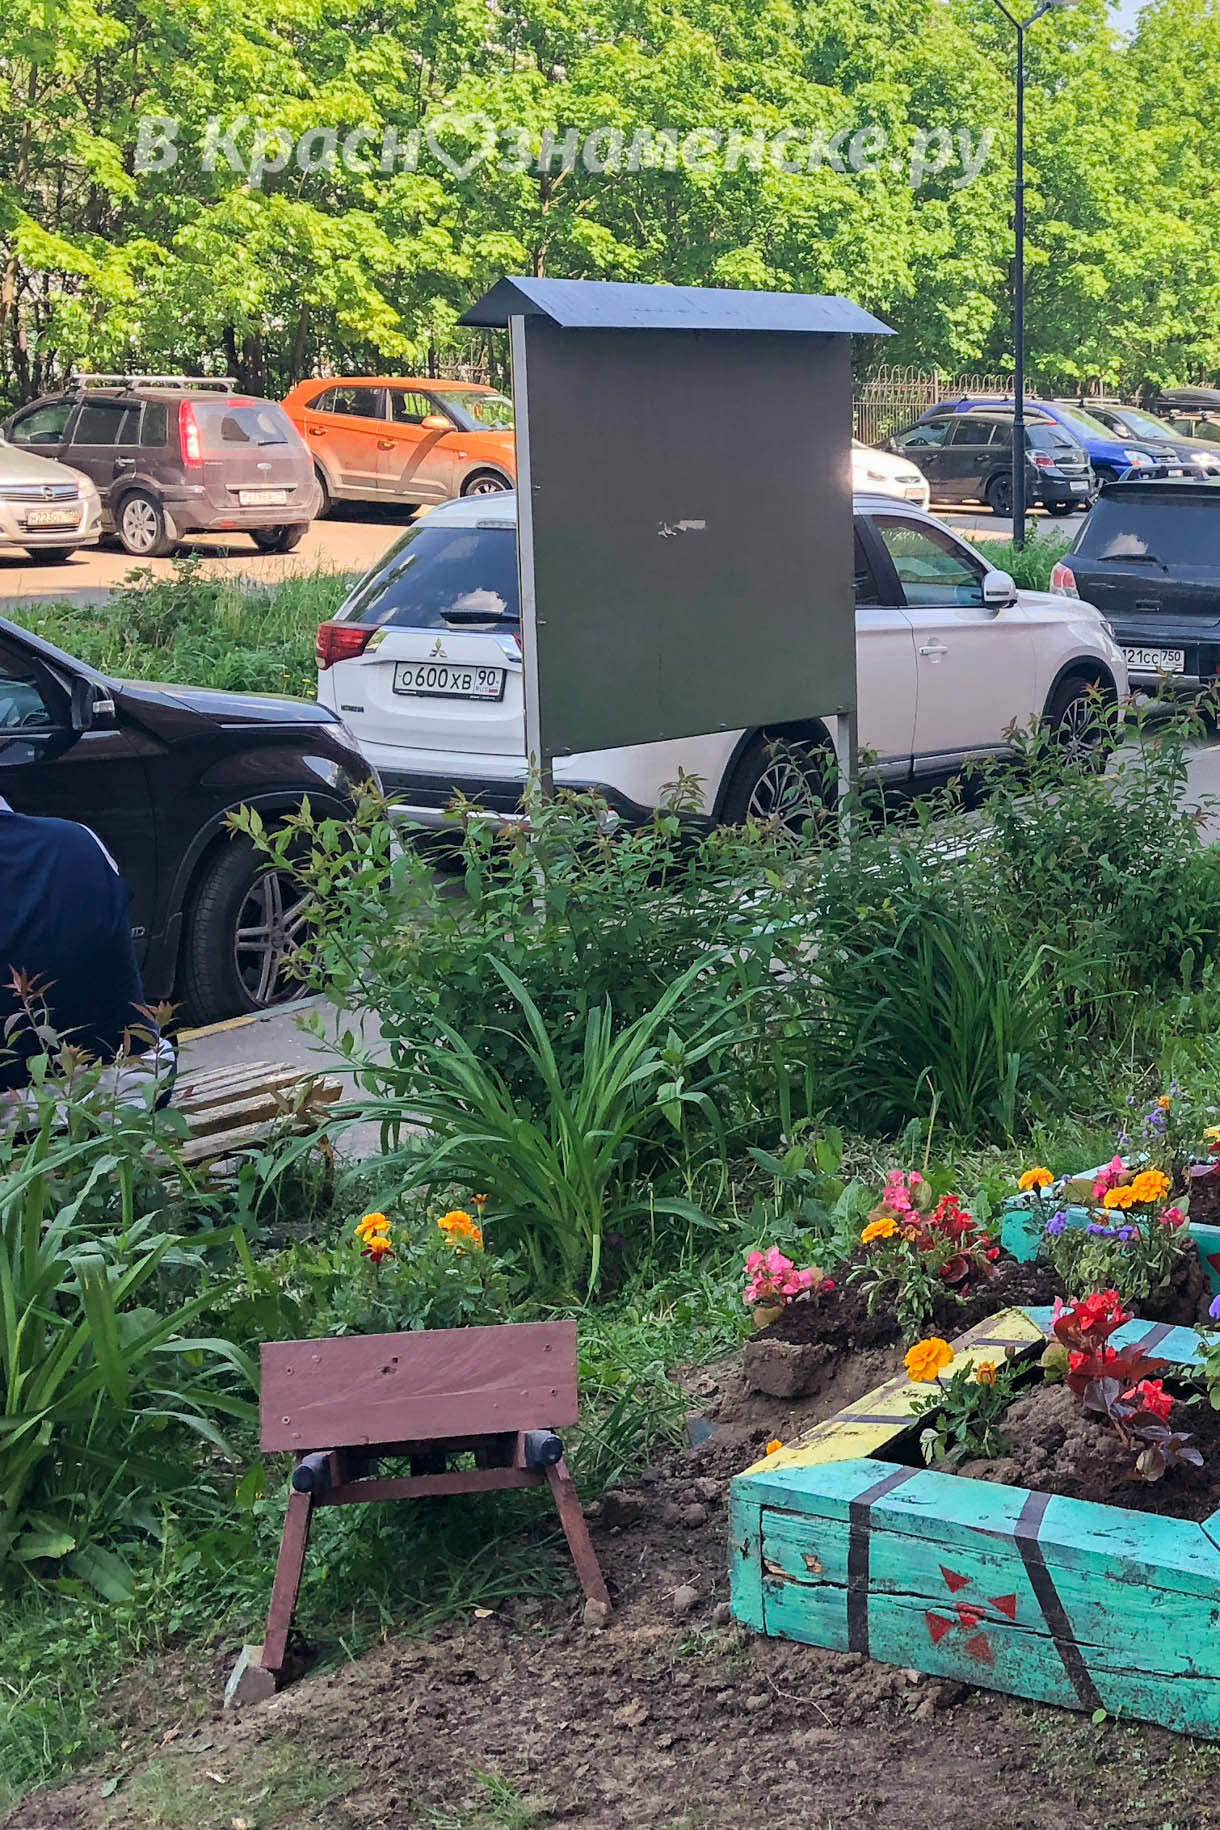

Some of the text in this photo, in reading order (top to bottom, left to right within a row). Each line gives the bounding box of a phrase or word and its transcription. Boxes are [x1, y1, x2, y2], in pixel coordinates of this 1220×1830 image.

[1121, 649, 1181, 664] 121СС 750
[402, 666, 496, 690] О600ХВ 90
